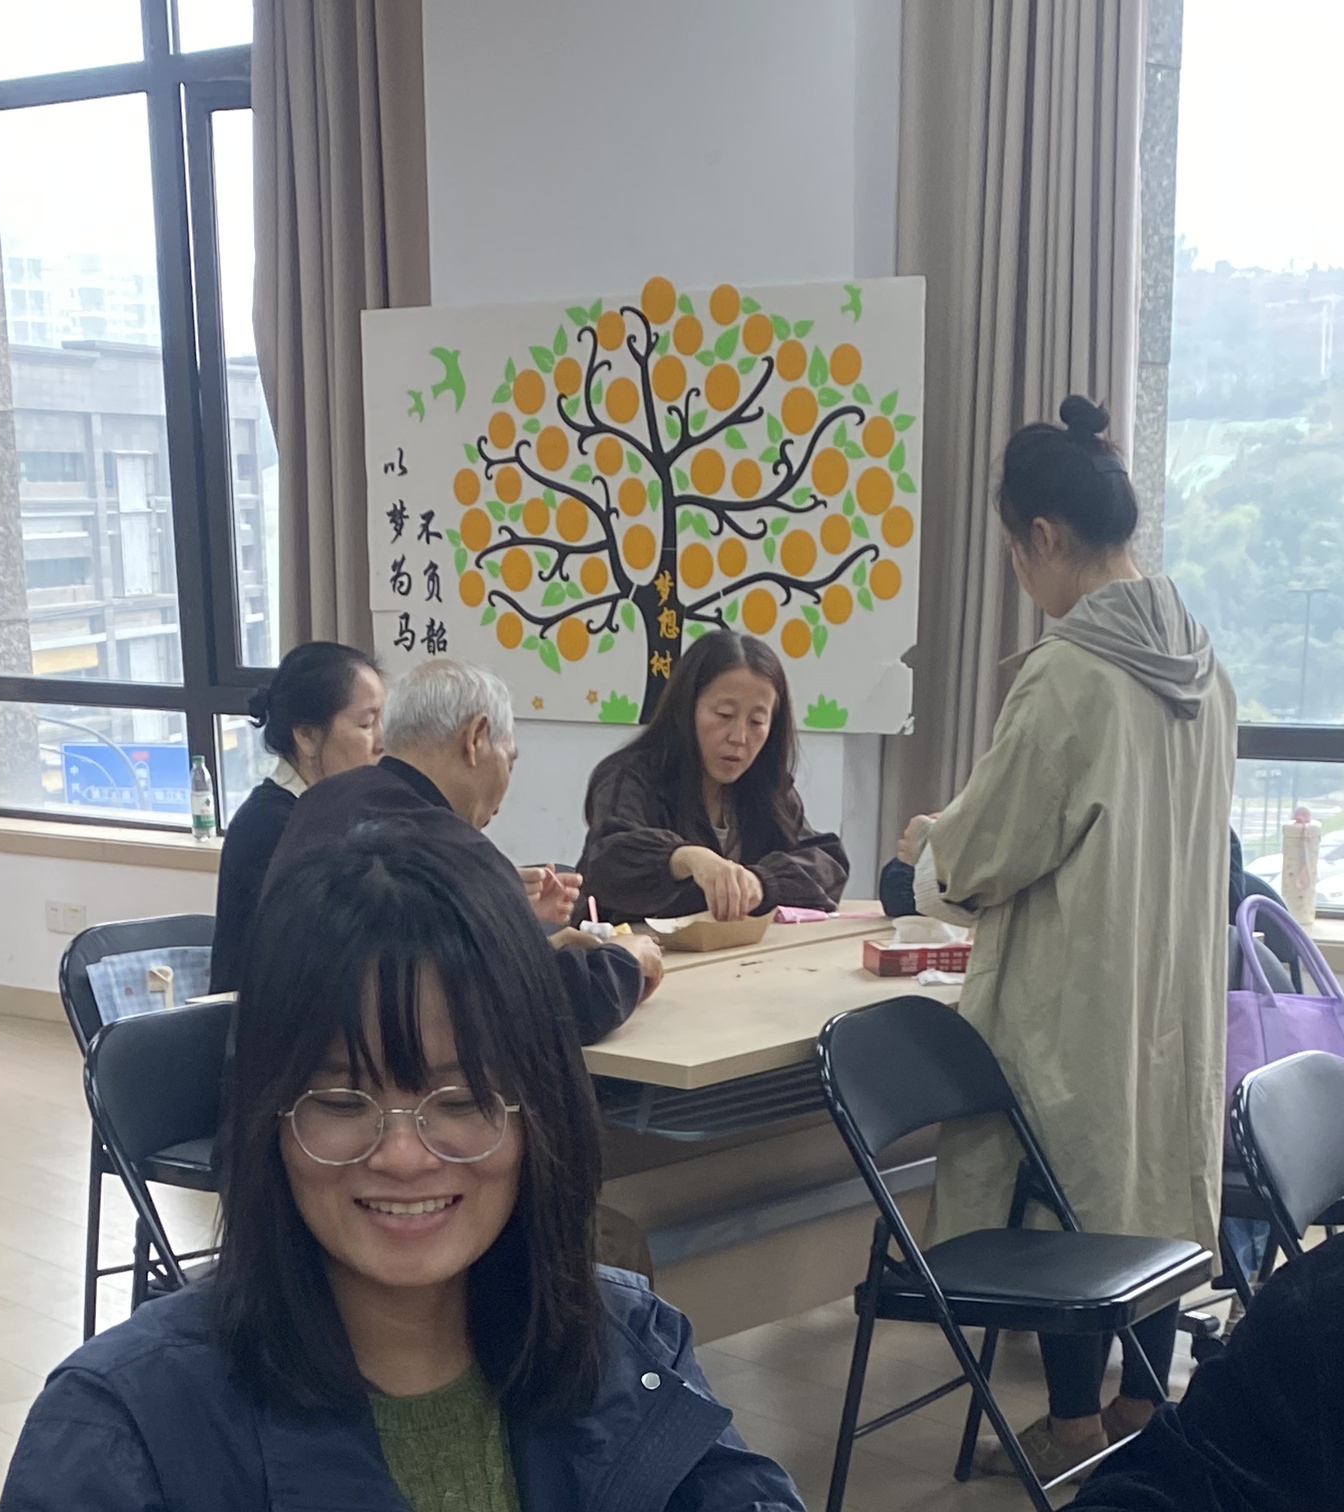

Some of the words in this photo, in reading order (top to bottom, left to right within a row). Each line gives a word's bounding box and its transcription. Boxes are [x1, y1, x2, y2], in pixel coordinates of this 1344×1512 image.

[384, 447, 416, 652] 以梦为马
[417, 509, 449, 656] 不负韶
[650, 569, 680, 679] 梦想树
